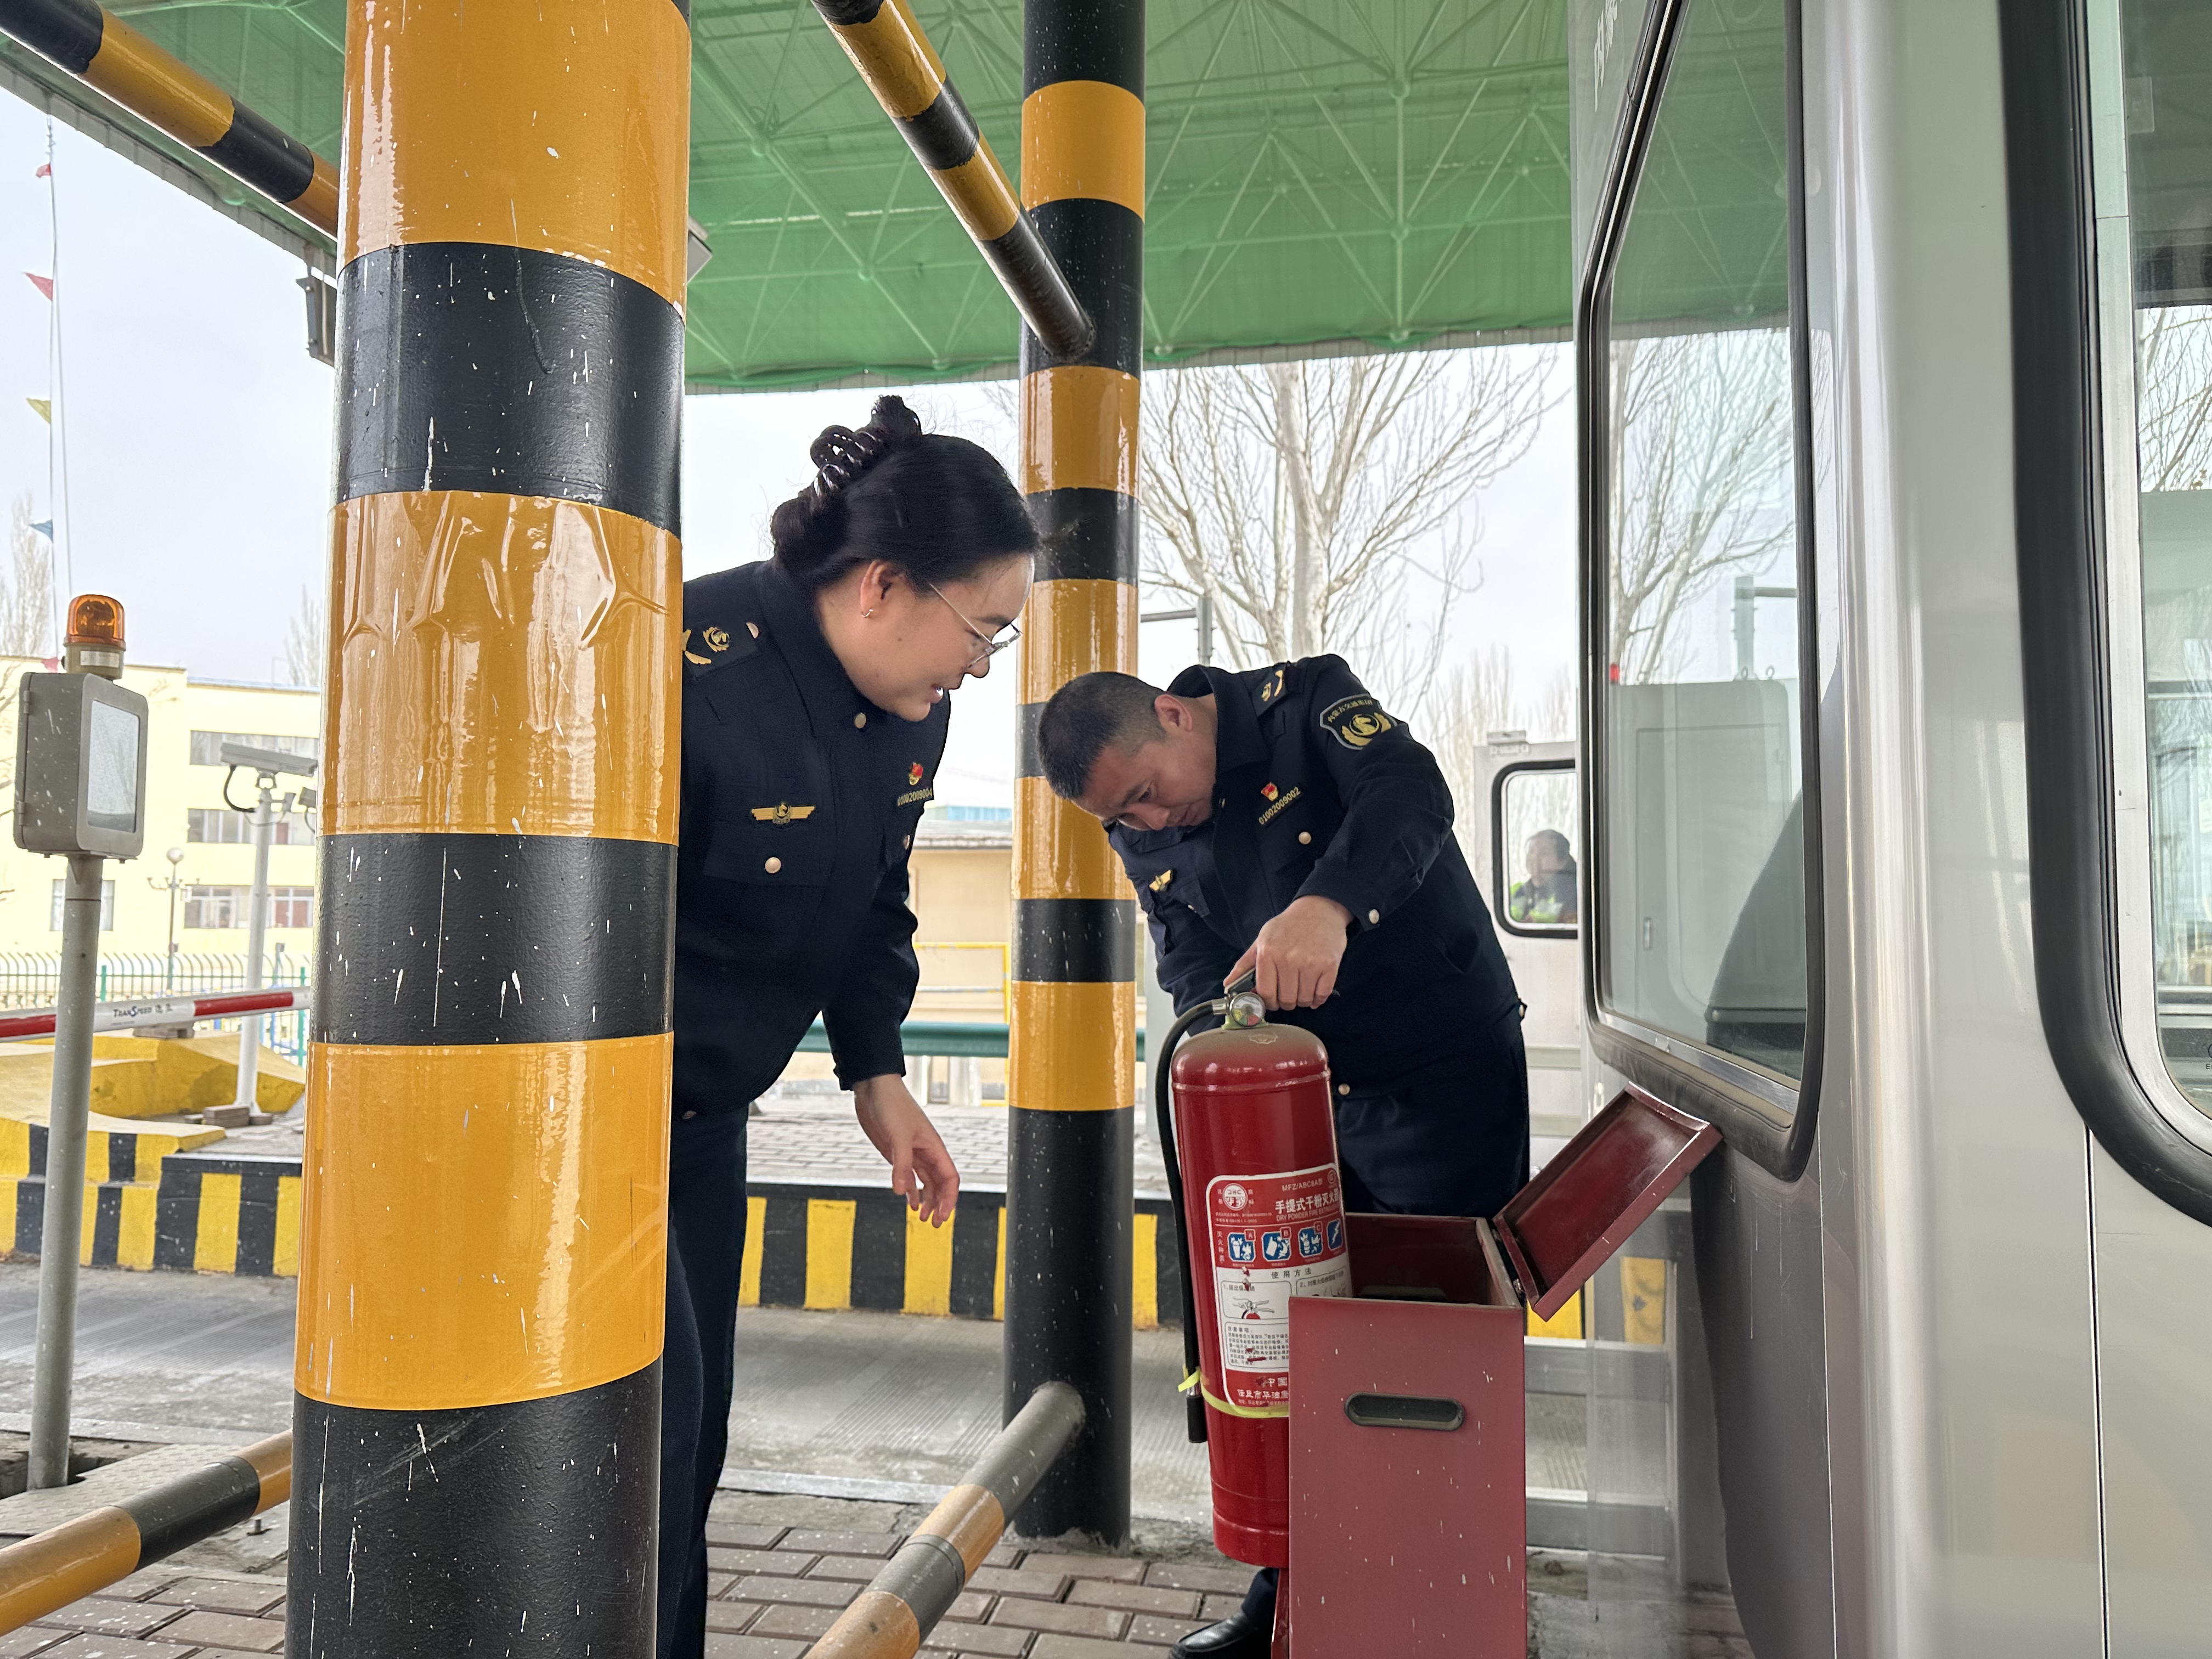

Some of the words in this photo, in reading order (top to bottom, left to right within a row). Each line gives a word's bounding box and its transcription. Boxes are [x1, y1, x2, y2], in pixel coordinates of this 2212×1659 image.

[1259, 787, 1301, 825] 01002009002
[1274, 1188, 1339, 1214] 手提式干粉灭火器
[1288, 1211, 1308, 1220] POWDER
[1271, 1267, 1312, 1279] 使用方法
